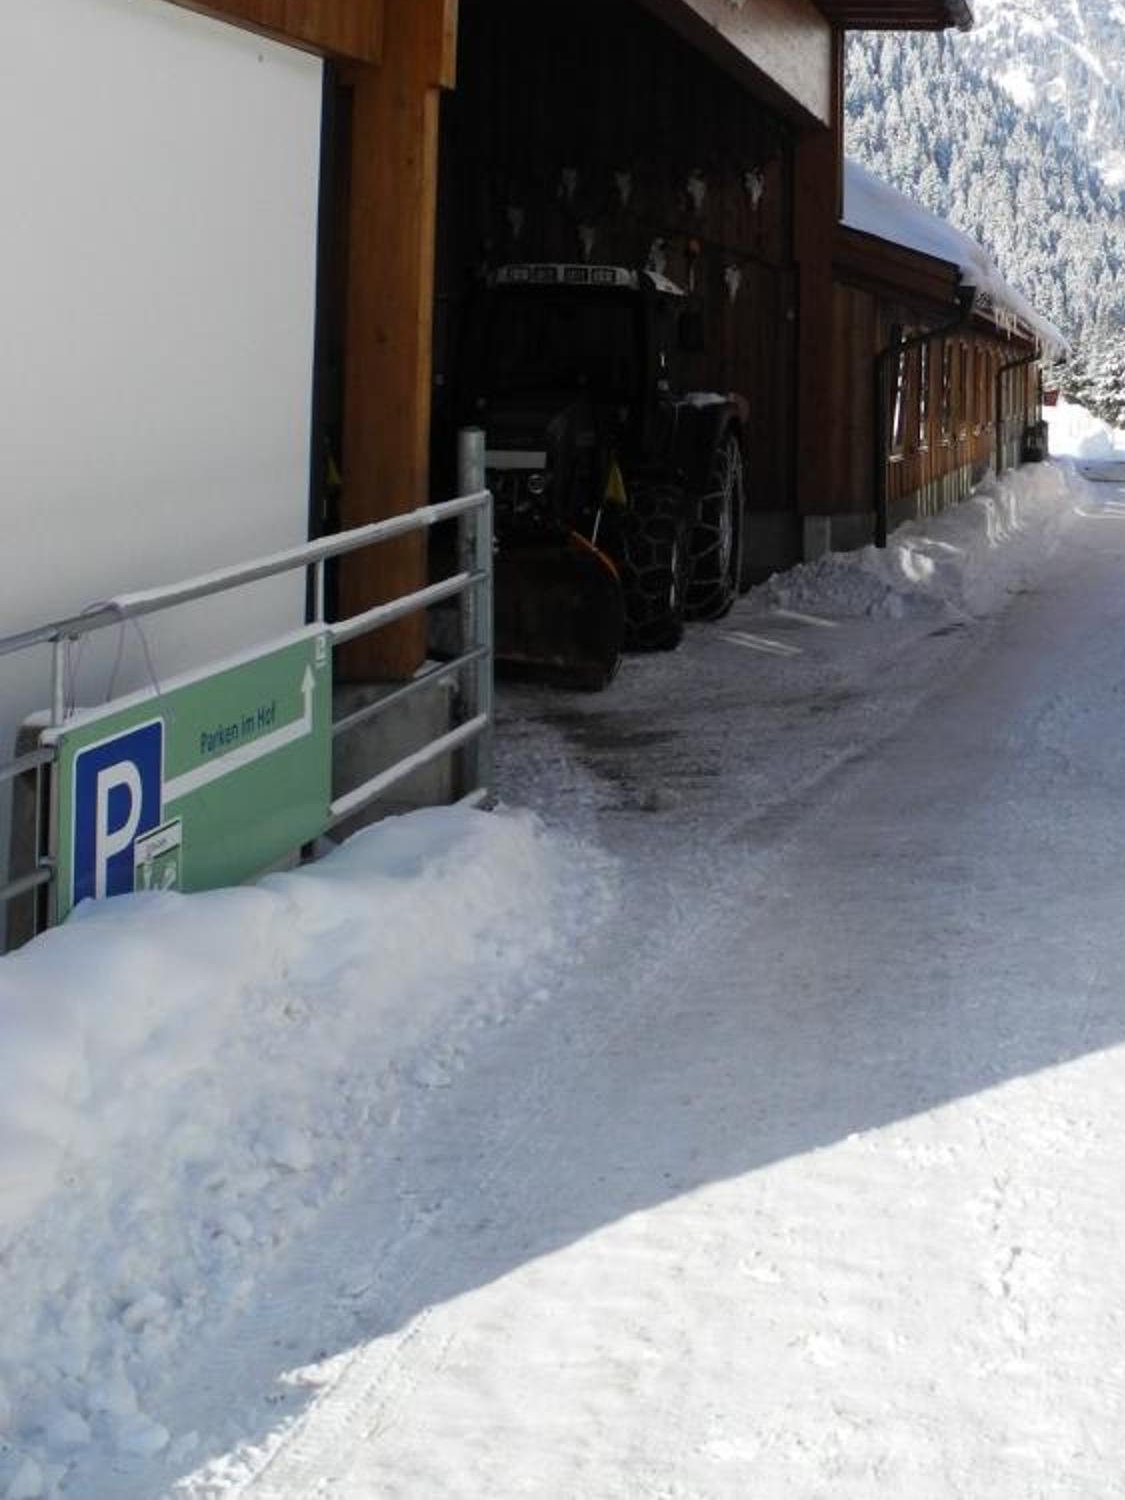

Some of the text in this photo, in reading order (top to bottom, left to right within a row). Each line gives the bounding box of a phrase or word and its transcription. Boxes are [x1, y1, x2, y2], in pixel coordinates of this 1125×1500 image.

[201, 699, 276, 755] Parken im Hof
[96, 759, 143, 900] P
